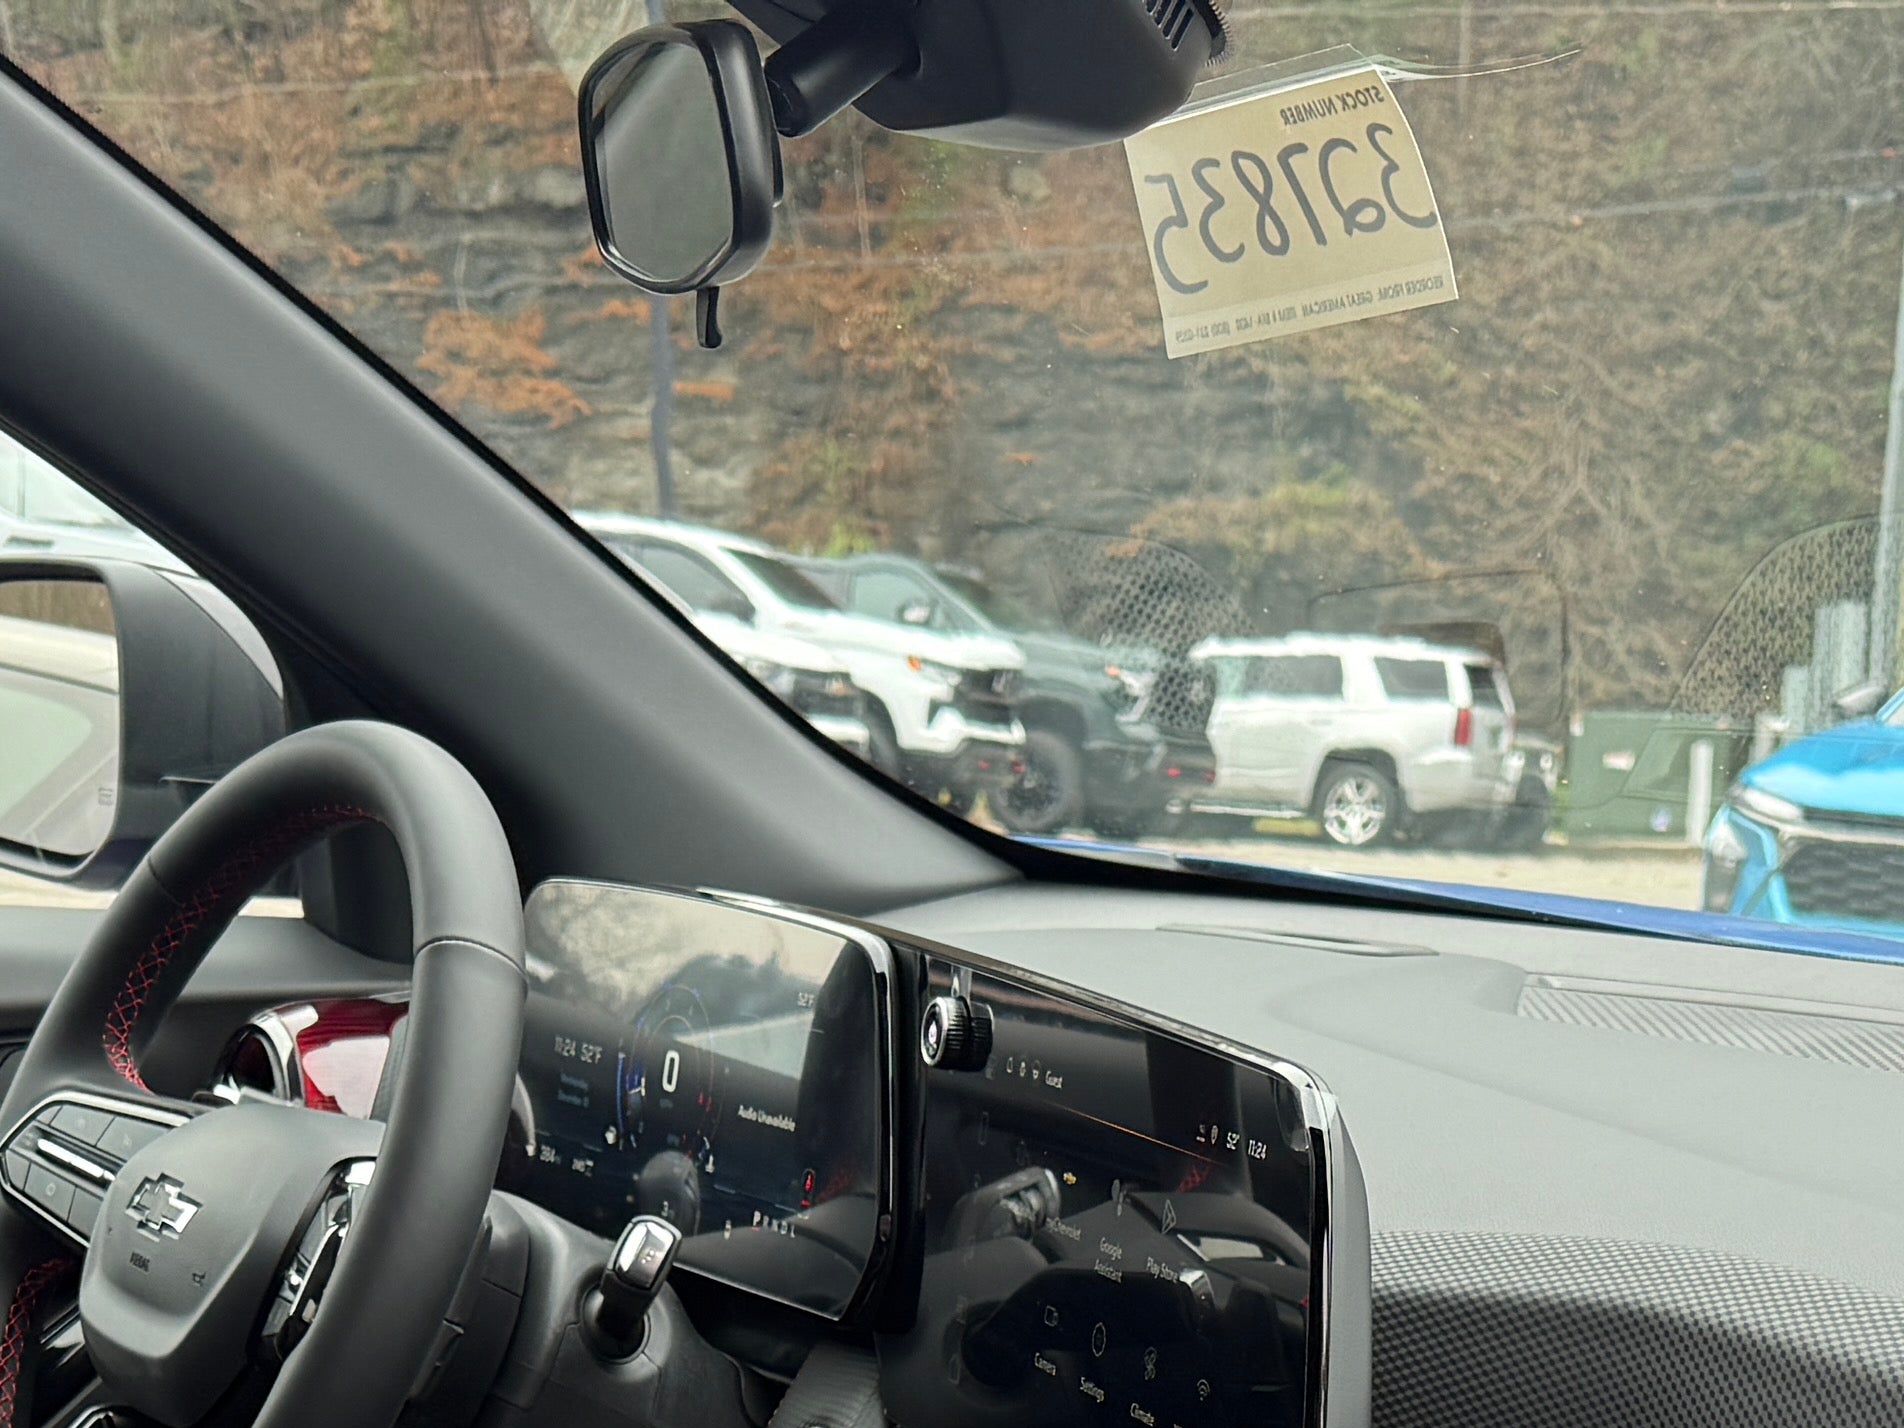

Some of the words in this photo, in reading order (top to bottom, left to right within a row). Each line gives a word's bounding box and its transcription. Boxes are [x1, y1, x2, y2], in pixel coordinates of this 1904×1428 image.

[662, 1050, 680, 1093] 0
[1100, 1237, 1122, 1260] Google
[1094, 1259, 1122, 1283] Assistant
[1147, 1257, 1162, 1281] Play
